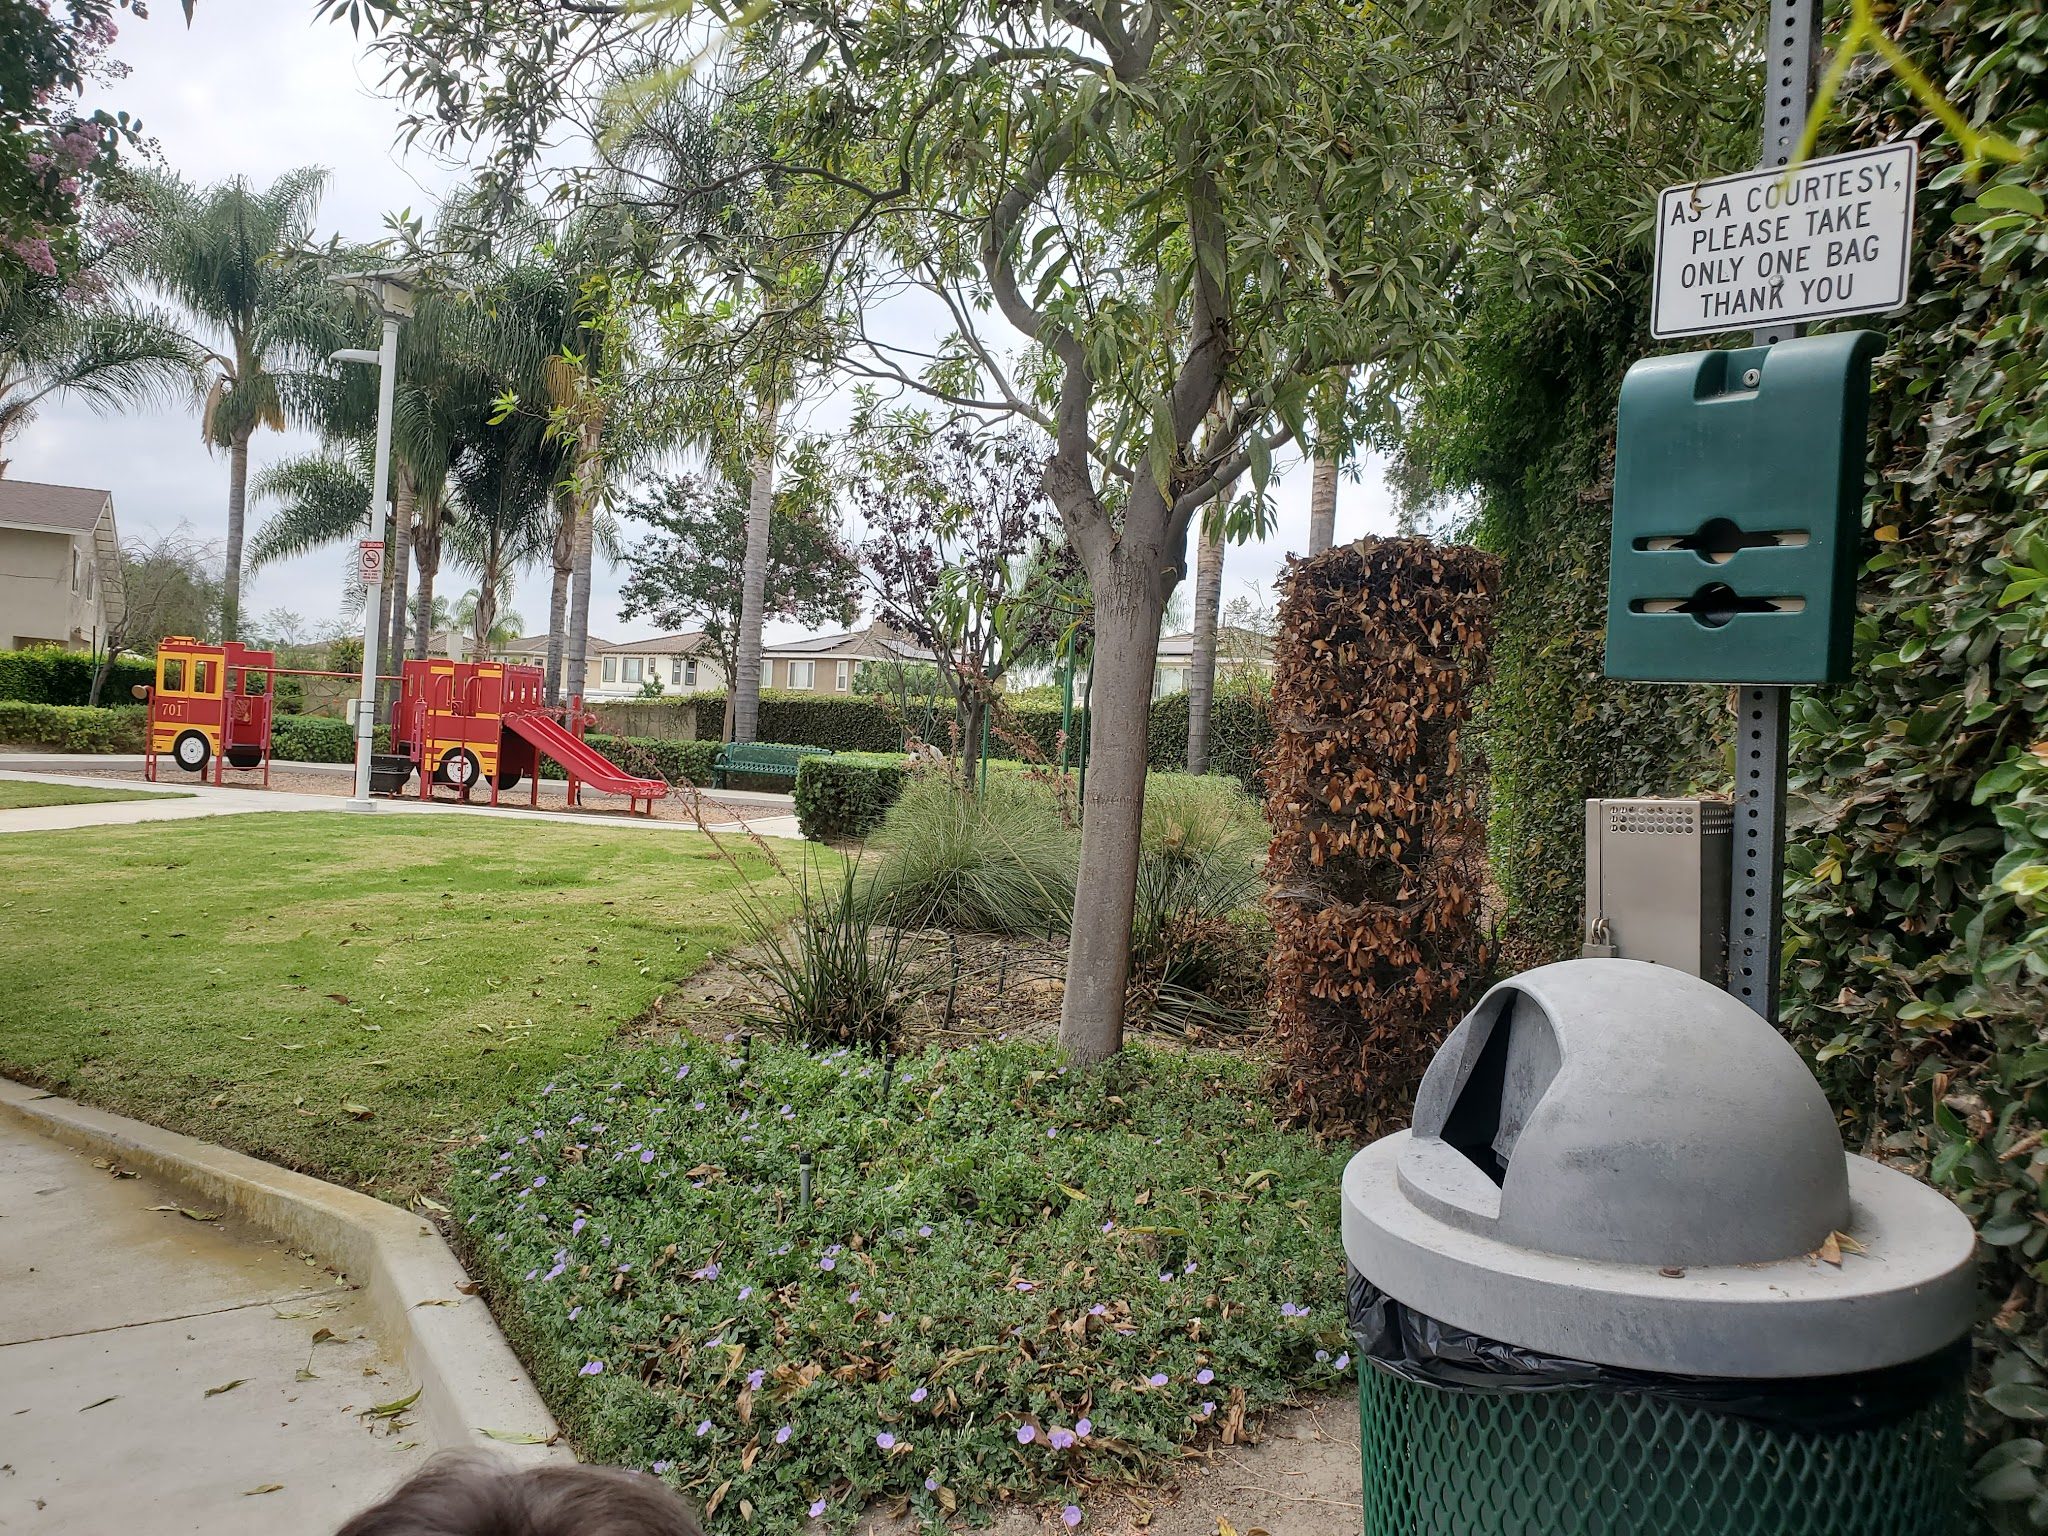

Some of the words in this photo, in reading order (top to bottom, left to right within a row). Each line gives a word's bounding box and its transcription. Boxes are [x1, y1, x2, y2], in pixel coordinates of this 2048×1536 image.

[1670, 196, 1702, 226] AS
[1715, 192, 1732, 219] A
[1746, 162, 1901, 213] COURTESY,
[1692, 215, 1790, 255] PLEASE
[1806, 201, 1872, 237] TAKE
[1681, 255, 1744, 289] ONLY
[1757, 246, 1811, 278] ONE
[1826, 235, 1879, 267] BAG
[1701, 283, 1784, 318] THANK
[1799, 273, 1854, 304] YOU
[162, 703, 182, 716] 701
